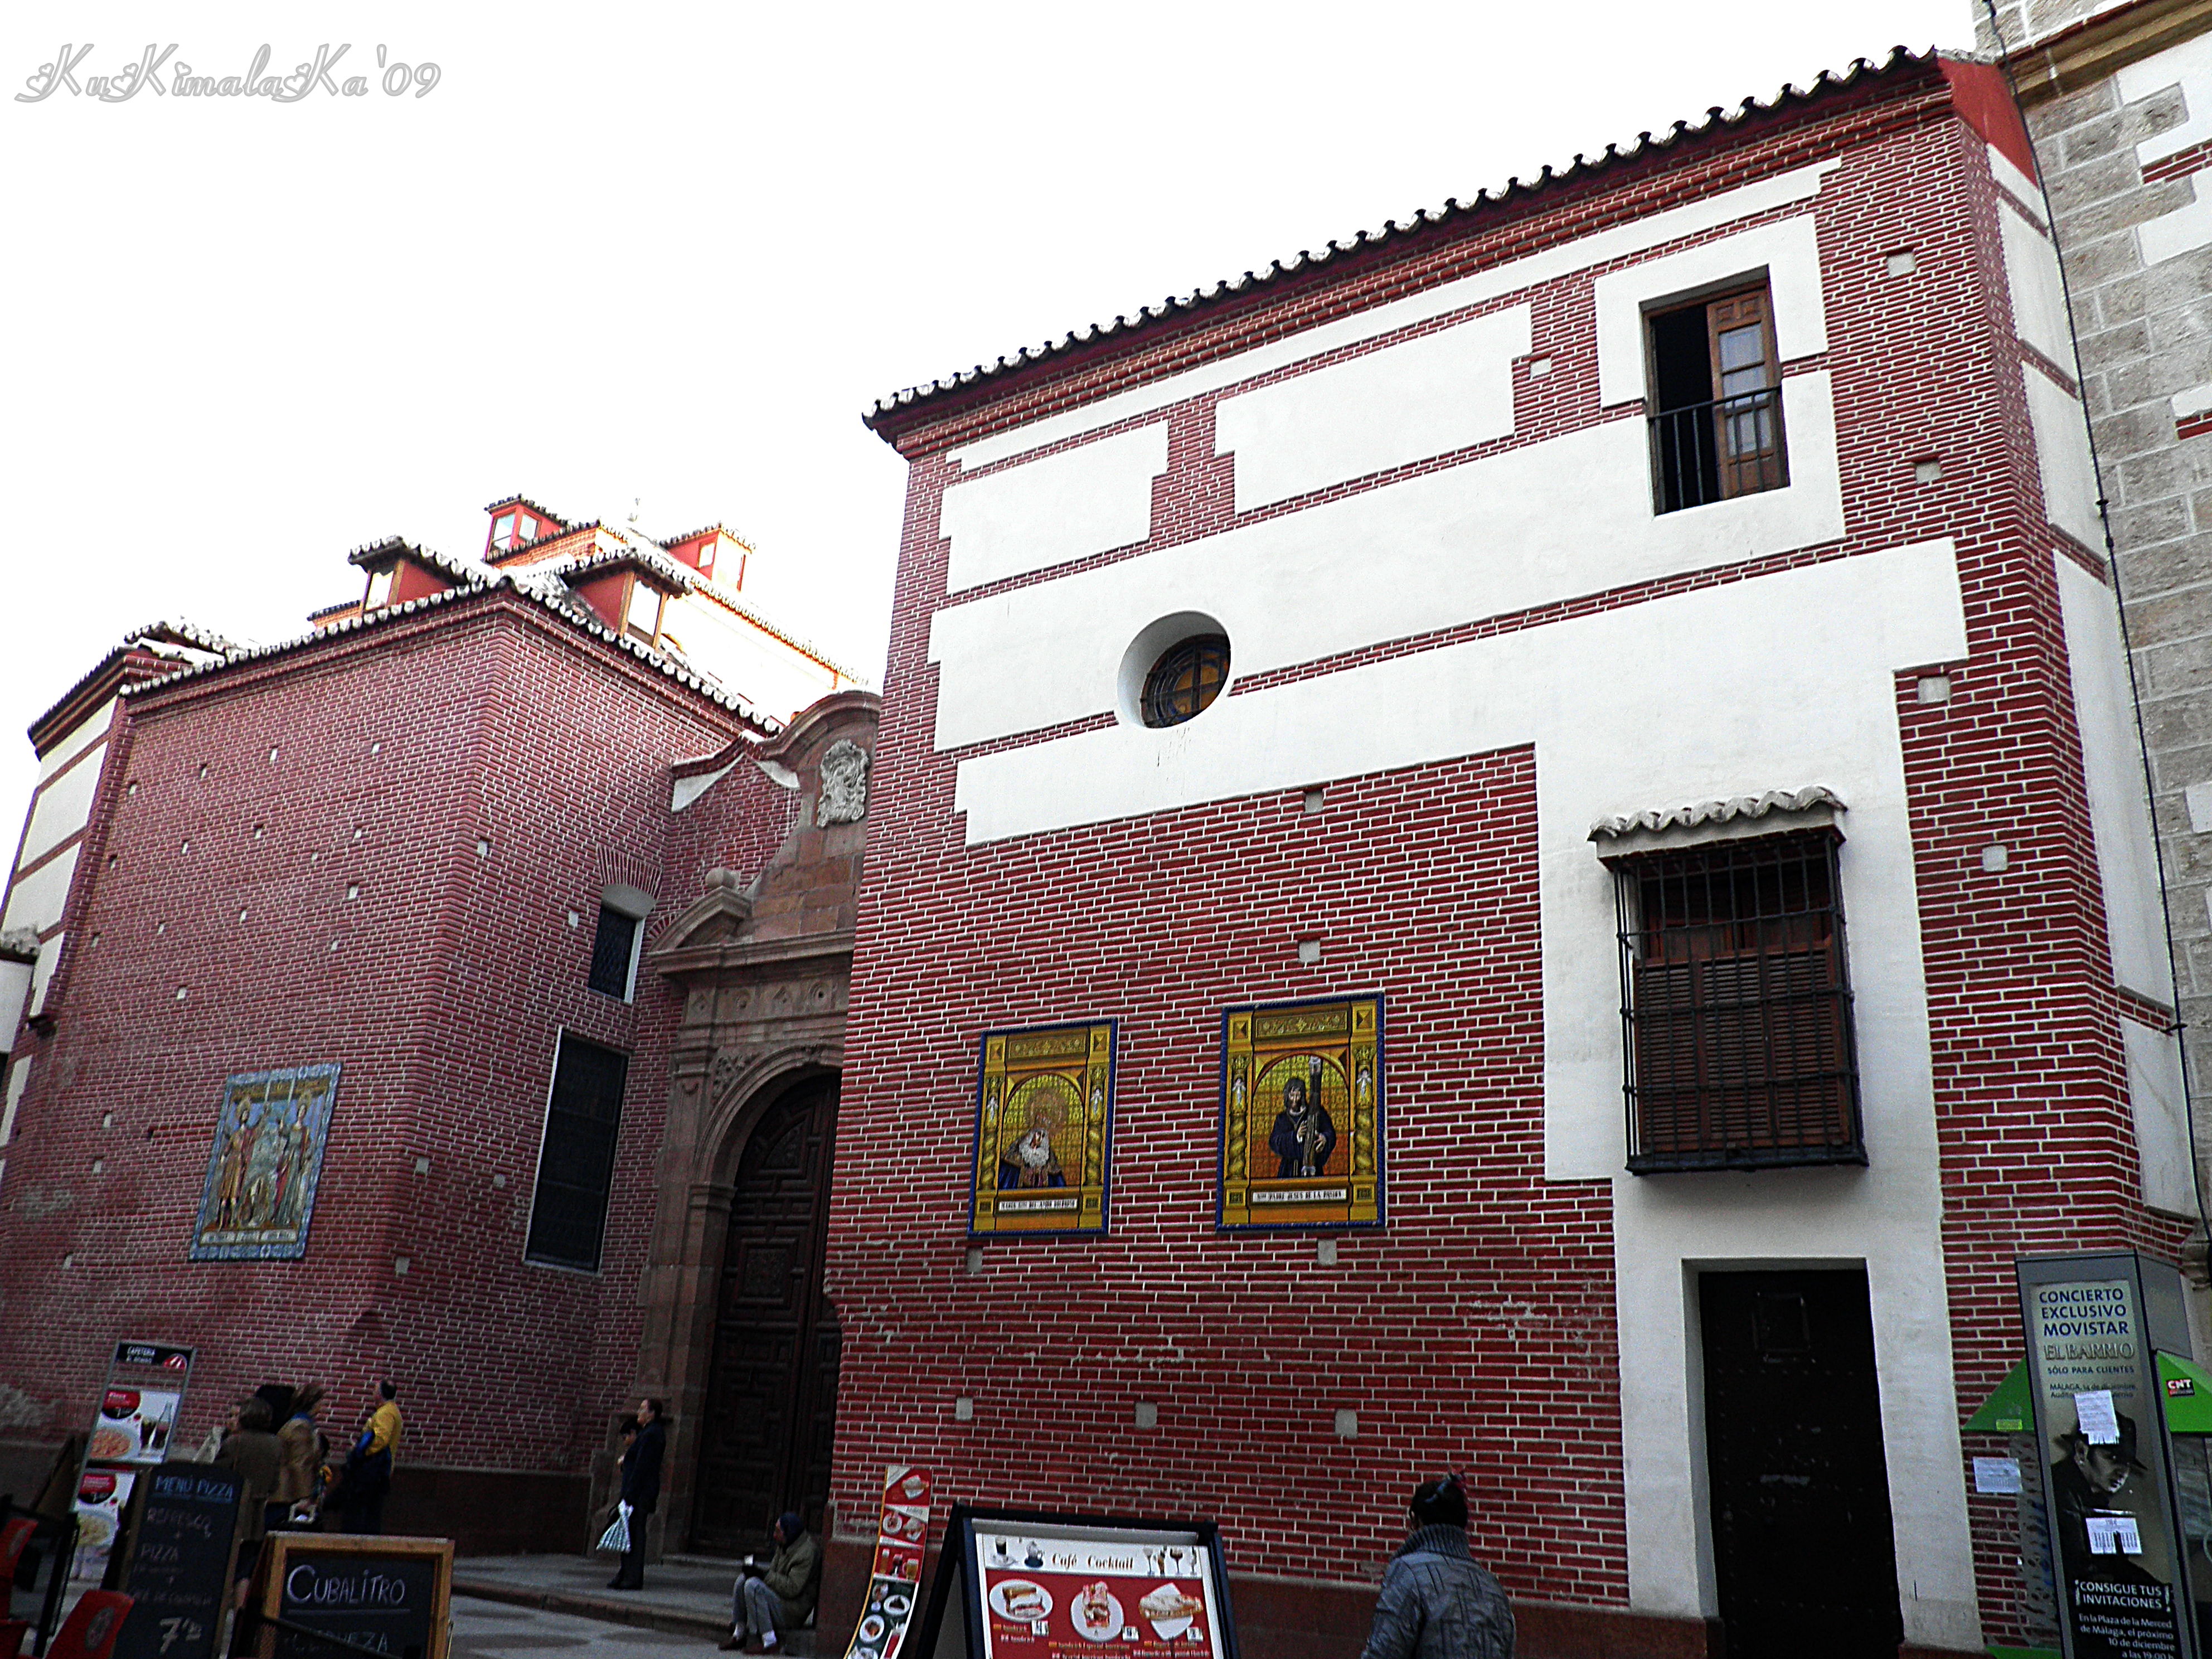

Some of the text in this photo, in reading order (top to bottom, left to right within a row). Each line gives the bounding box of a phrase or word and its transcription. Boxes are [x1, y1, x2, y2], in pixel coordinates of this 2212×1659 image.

[2039, 1288, 2123, 1303] CONCIERTO
[2041, 1304, 2127, 1319] EXCLUSIVO
[2044, 1321, 2129, 1336] MOVISTAR
[2044, 1342, 2135, 1360] EL BARRIO
[2048, 1365, 2134, 1374] SÓLO PARA CLIENTES
[2168, 1379, 2191, 1389] CNT
[197, 1479, 234, 1498] PIZZA
[141, 1544, 179, 1561] PIZZA
[1052, 1553, 1133, 1570] Café Cocktail
[2140, 1585, 2162, 1596] TUS
[2079, 1613, 2172, 1628] En la Plaza de la Merced
[2080, 1624, 2090, 1633] de
[2093, 1626, 2126, 1637] Málaga,
[2137, 1630, 2174, 1640] próximo
[2108, 1637, 2175, 1651] 10 de diciembre
[2129, 1650, 2141, 1658] las
